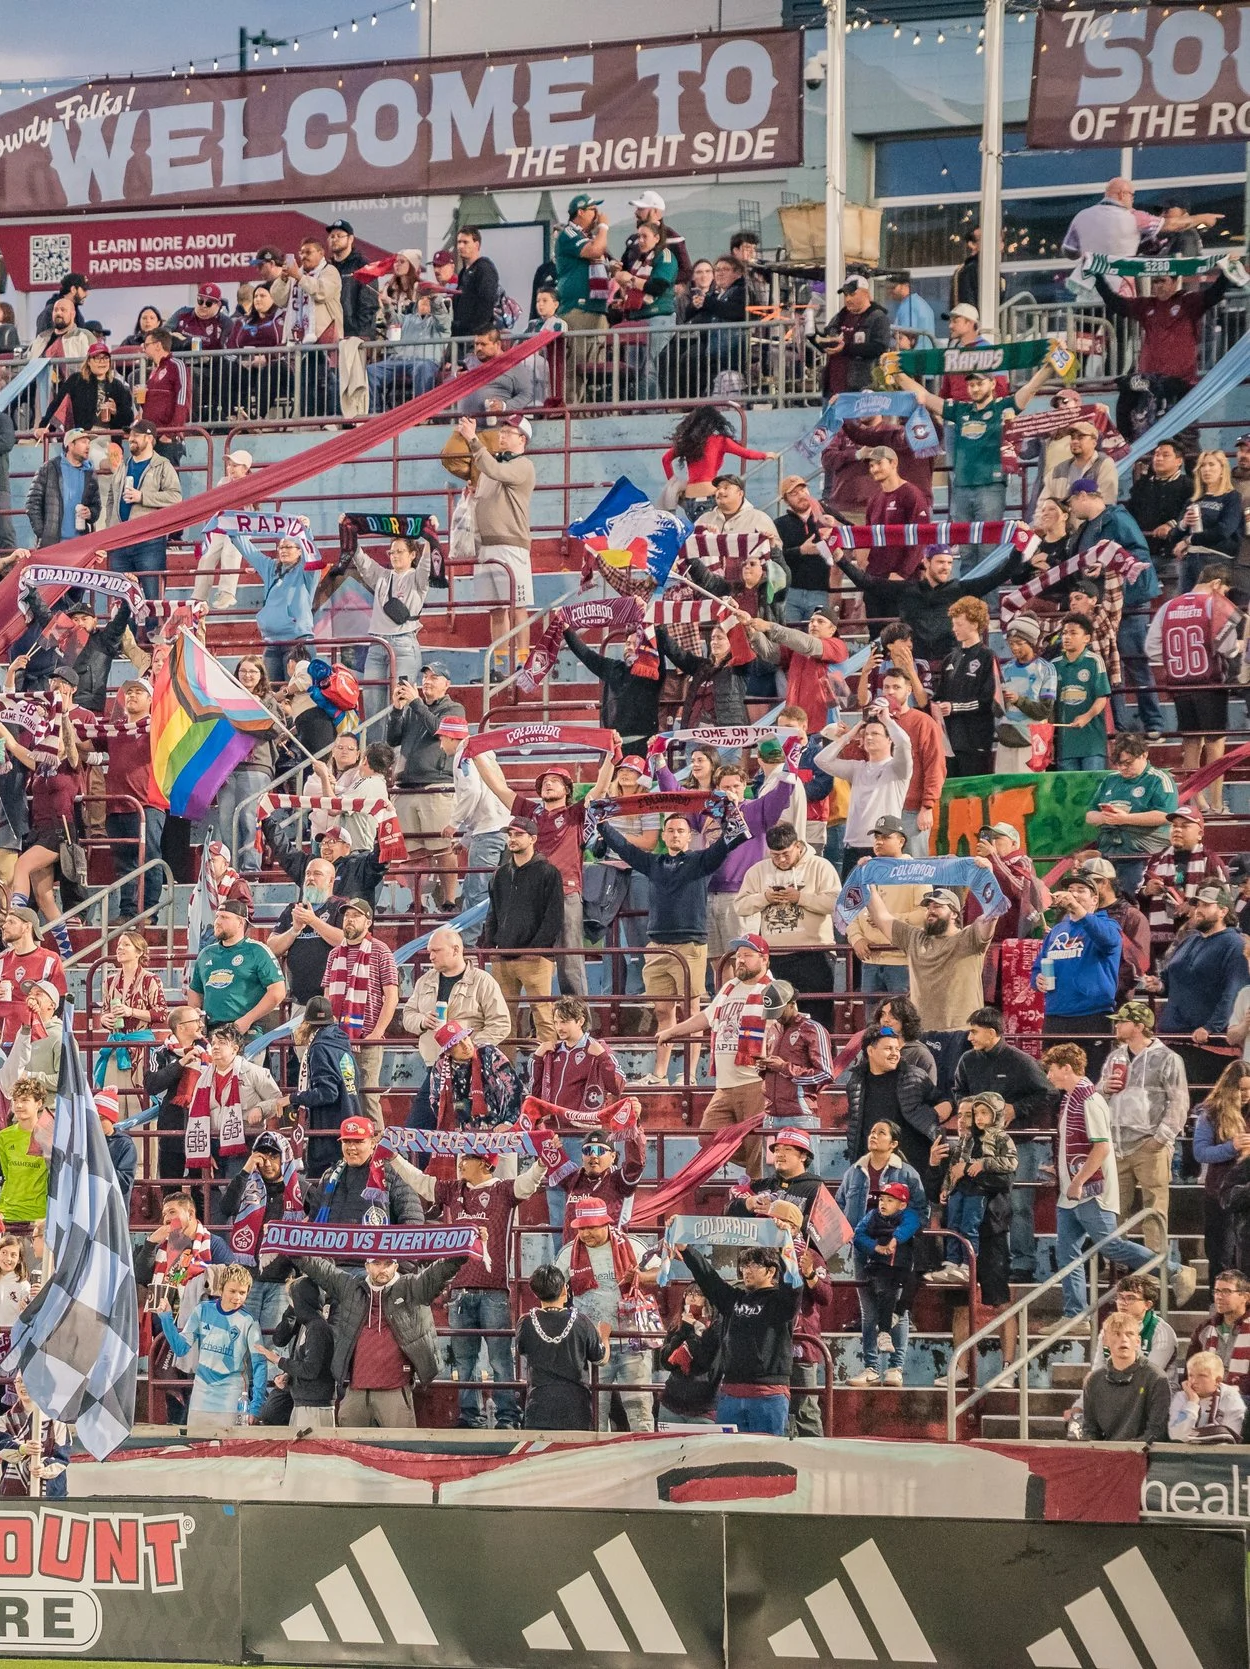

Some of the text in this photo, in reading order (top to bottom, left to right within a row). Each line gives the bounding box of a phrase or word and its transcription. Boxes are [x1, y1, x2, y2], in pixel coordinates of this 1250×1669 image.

[1062, 9, 1113, 48] The
[55, 86, 136, 130] Folks!
[50, 40, 779, 206] WELCOME TO
[1070, 108, 1120, 141] OF
[1127, 104, 1201, 139] THE
[505, 128, 779, 180] THE RIGHT SIDE
[89, 233, 237, 255] LEARN MORE ABOUT
[89, 257, 141, 274] RAPIDS
[145, 255, 204, 271] SEASON
[1145, 260, 1171, 272] 5280
[81, 574, 132, 593] RAPIDS
[571, 603, 613, 621] COLORADO
[581, 617, 607, 625] RAPIDS
[1167, 625, 1209, 678] 96
[506, 724, 561, 744] COLORADO
[518, 736, 549, 745] RAPIDS
[691, 729, 727, 740] COME
[732, 728, 748, 738] ON
[889, 862, 936, 879] COLORADO
[388, 1130, 524, 1150] UP THE PIDS
[695, 1216, 758, 1242] COLORADO
[352, 1231, 375, 1249] VS
[707, 1237, 746, 1245] RAPIDS
